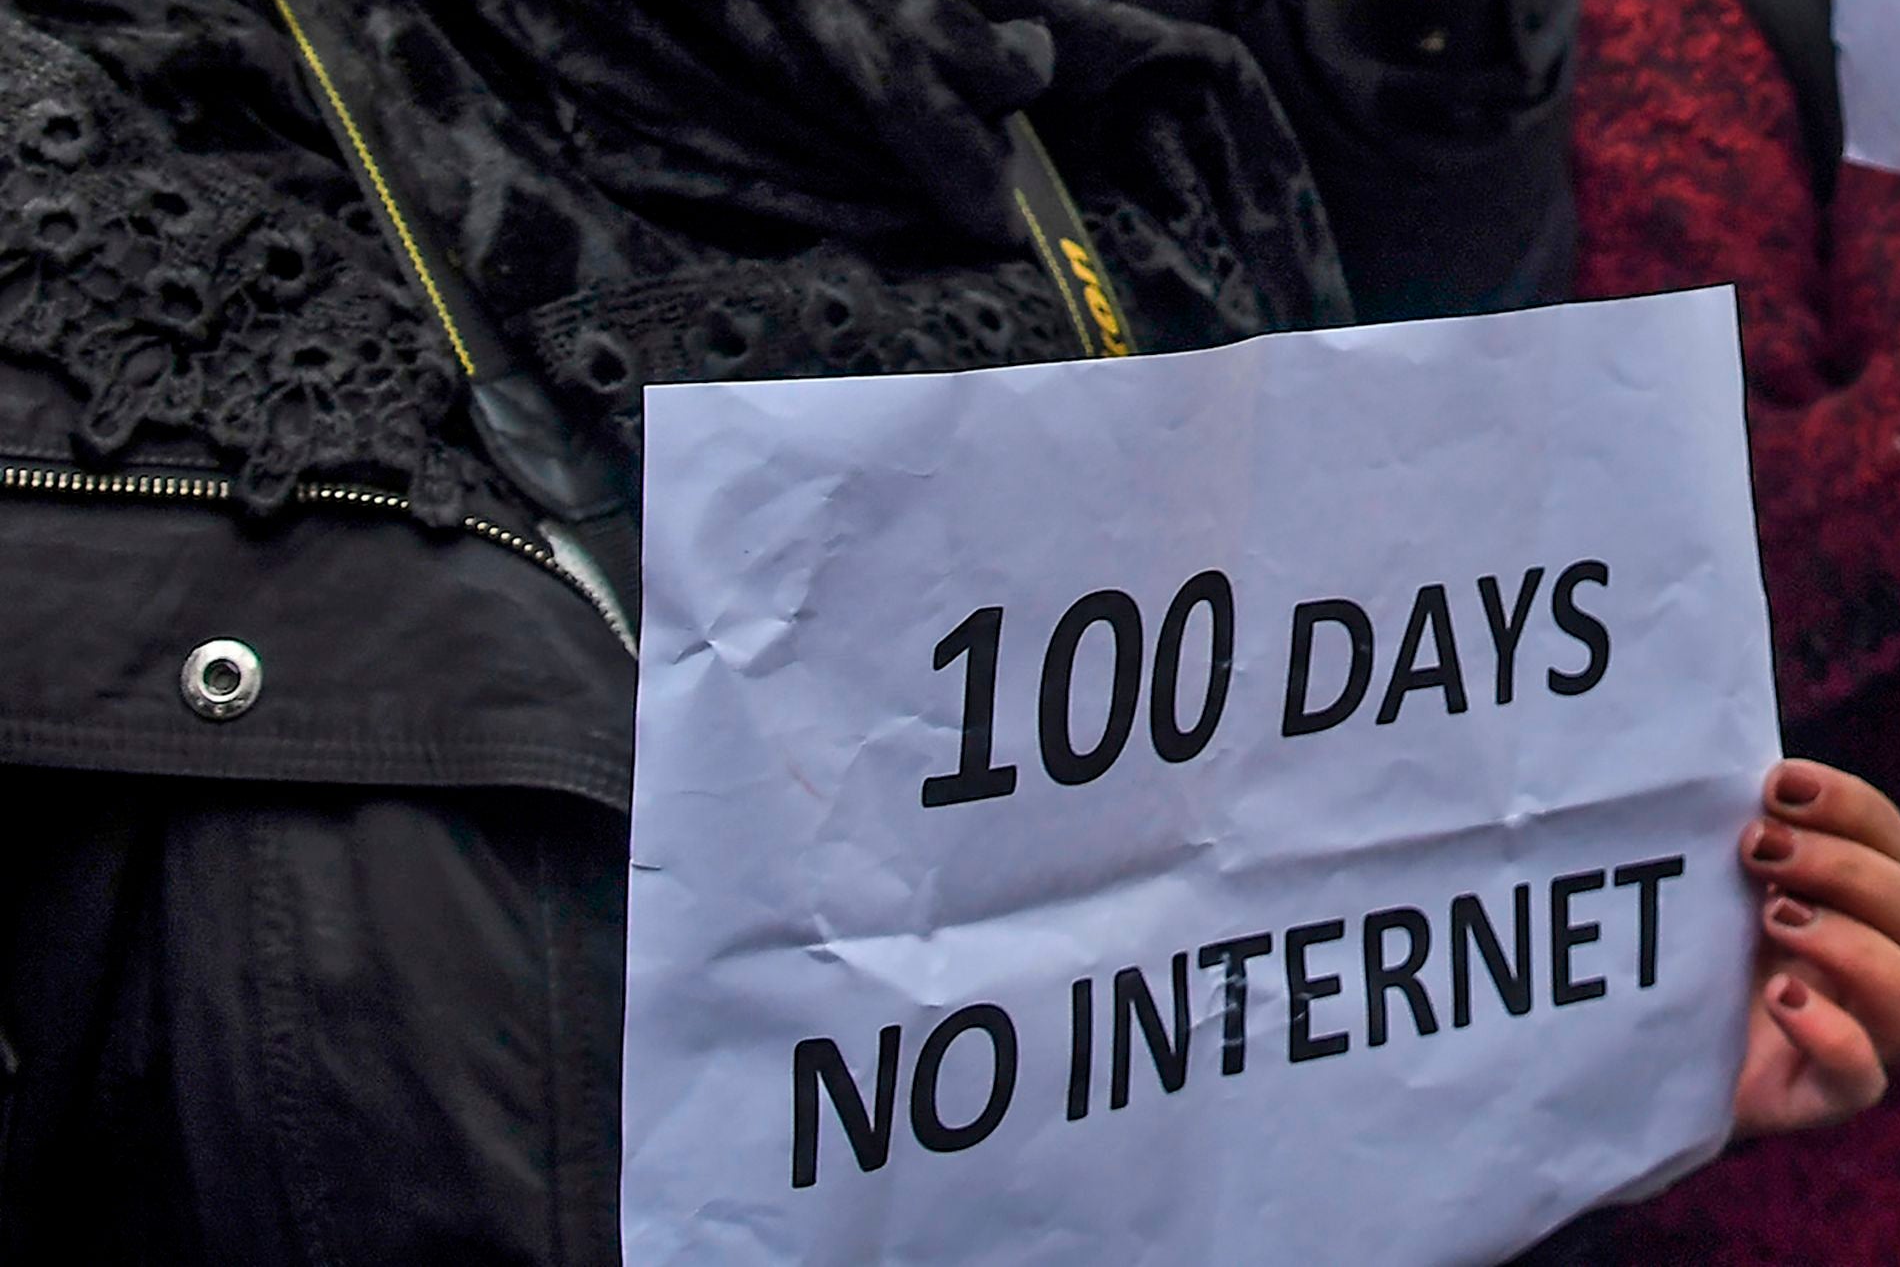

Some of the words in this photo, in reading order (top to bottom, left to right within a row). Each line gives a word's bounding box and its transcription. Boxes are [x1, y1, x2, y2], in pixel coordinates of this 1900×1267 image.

[921, 569, 1235, 809] 100
[1280, 559, 1611, 739] DAYS
[791, 1003, 1019, 1190] NO
[1066, 854, 1686, 1123] INTERNET
